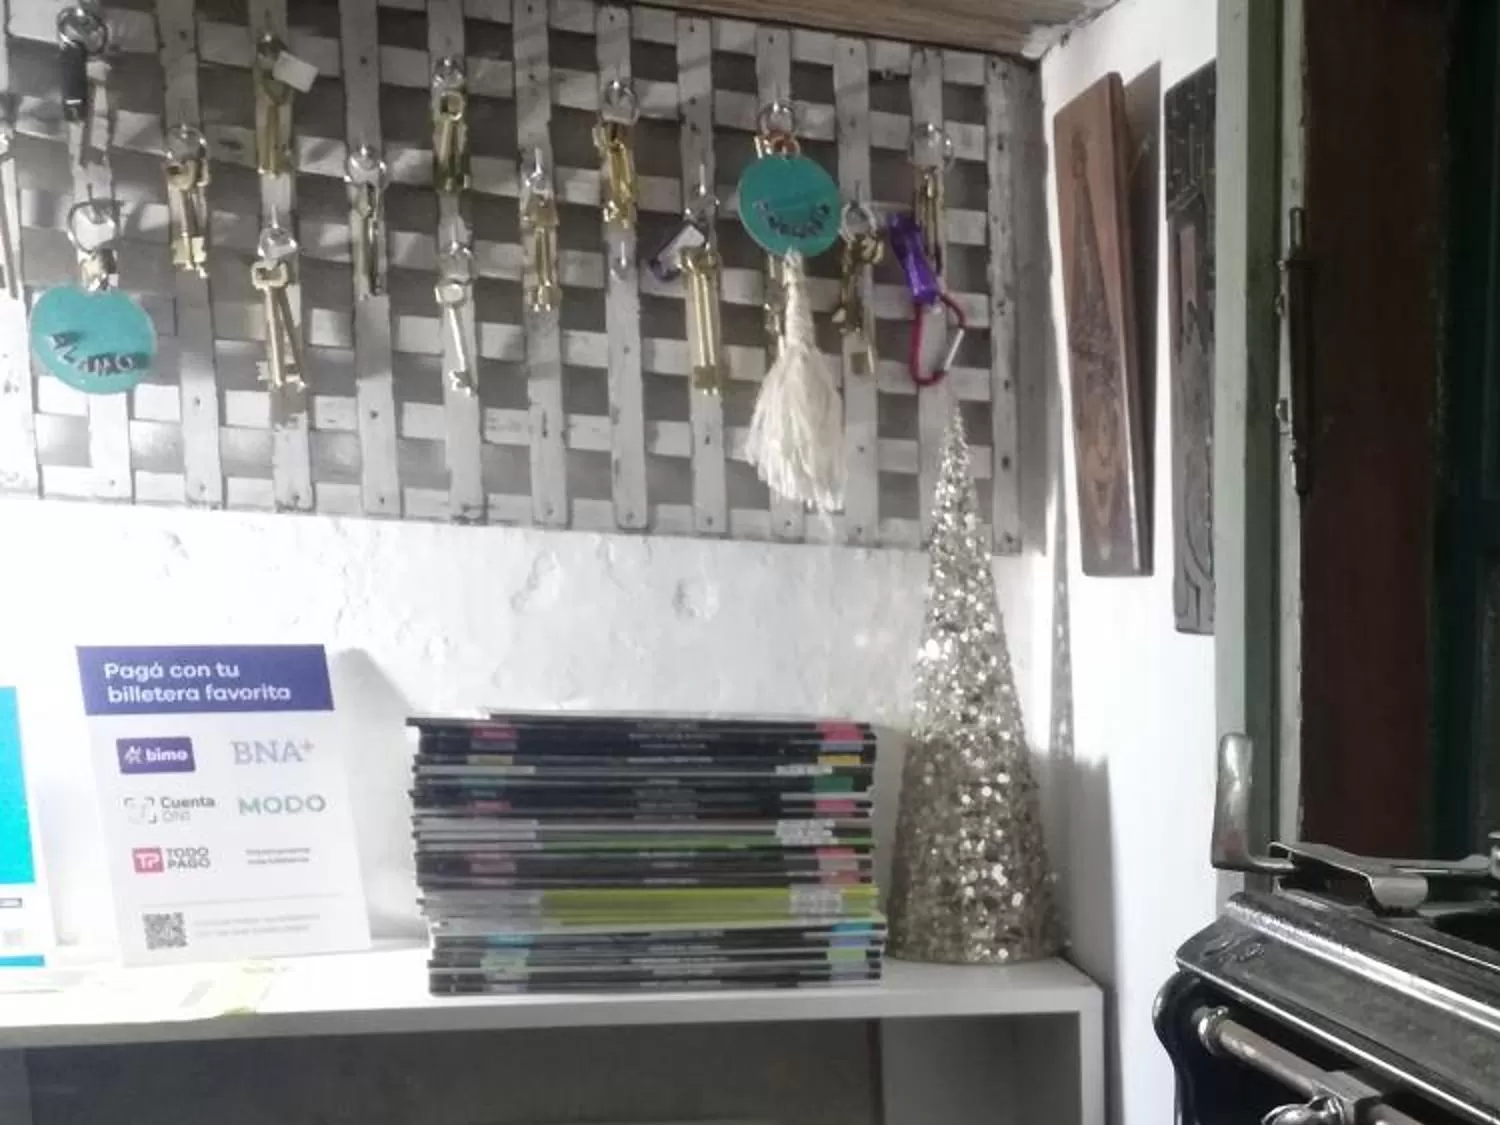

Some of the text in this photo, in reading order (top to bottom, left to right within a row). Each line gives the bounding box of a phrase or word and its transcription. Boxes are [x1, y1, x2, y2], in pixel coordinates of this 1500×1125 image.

[104, 662, 240, 682] Pagá con tu
[107, 683, 292, 703] billetera favorita
[145, 747, 189, 761] bimo
[160, 796, 216, 809] Cuenta
[238, 794, 326, 815] MODO
[166, 847, 209, 857] TODO
[167, 858, 211, 869] PAGO
